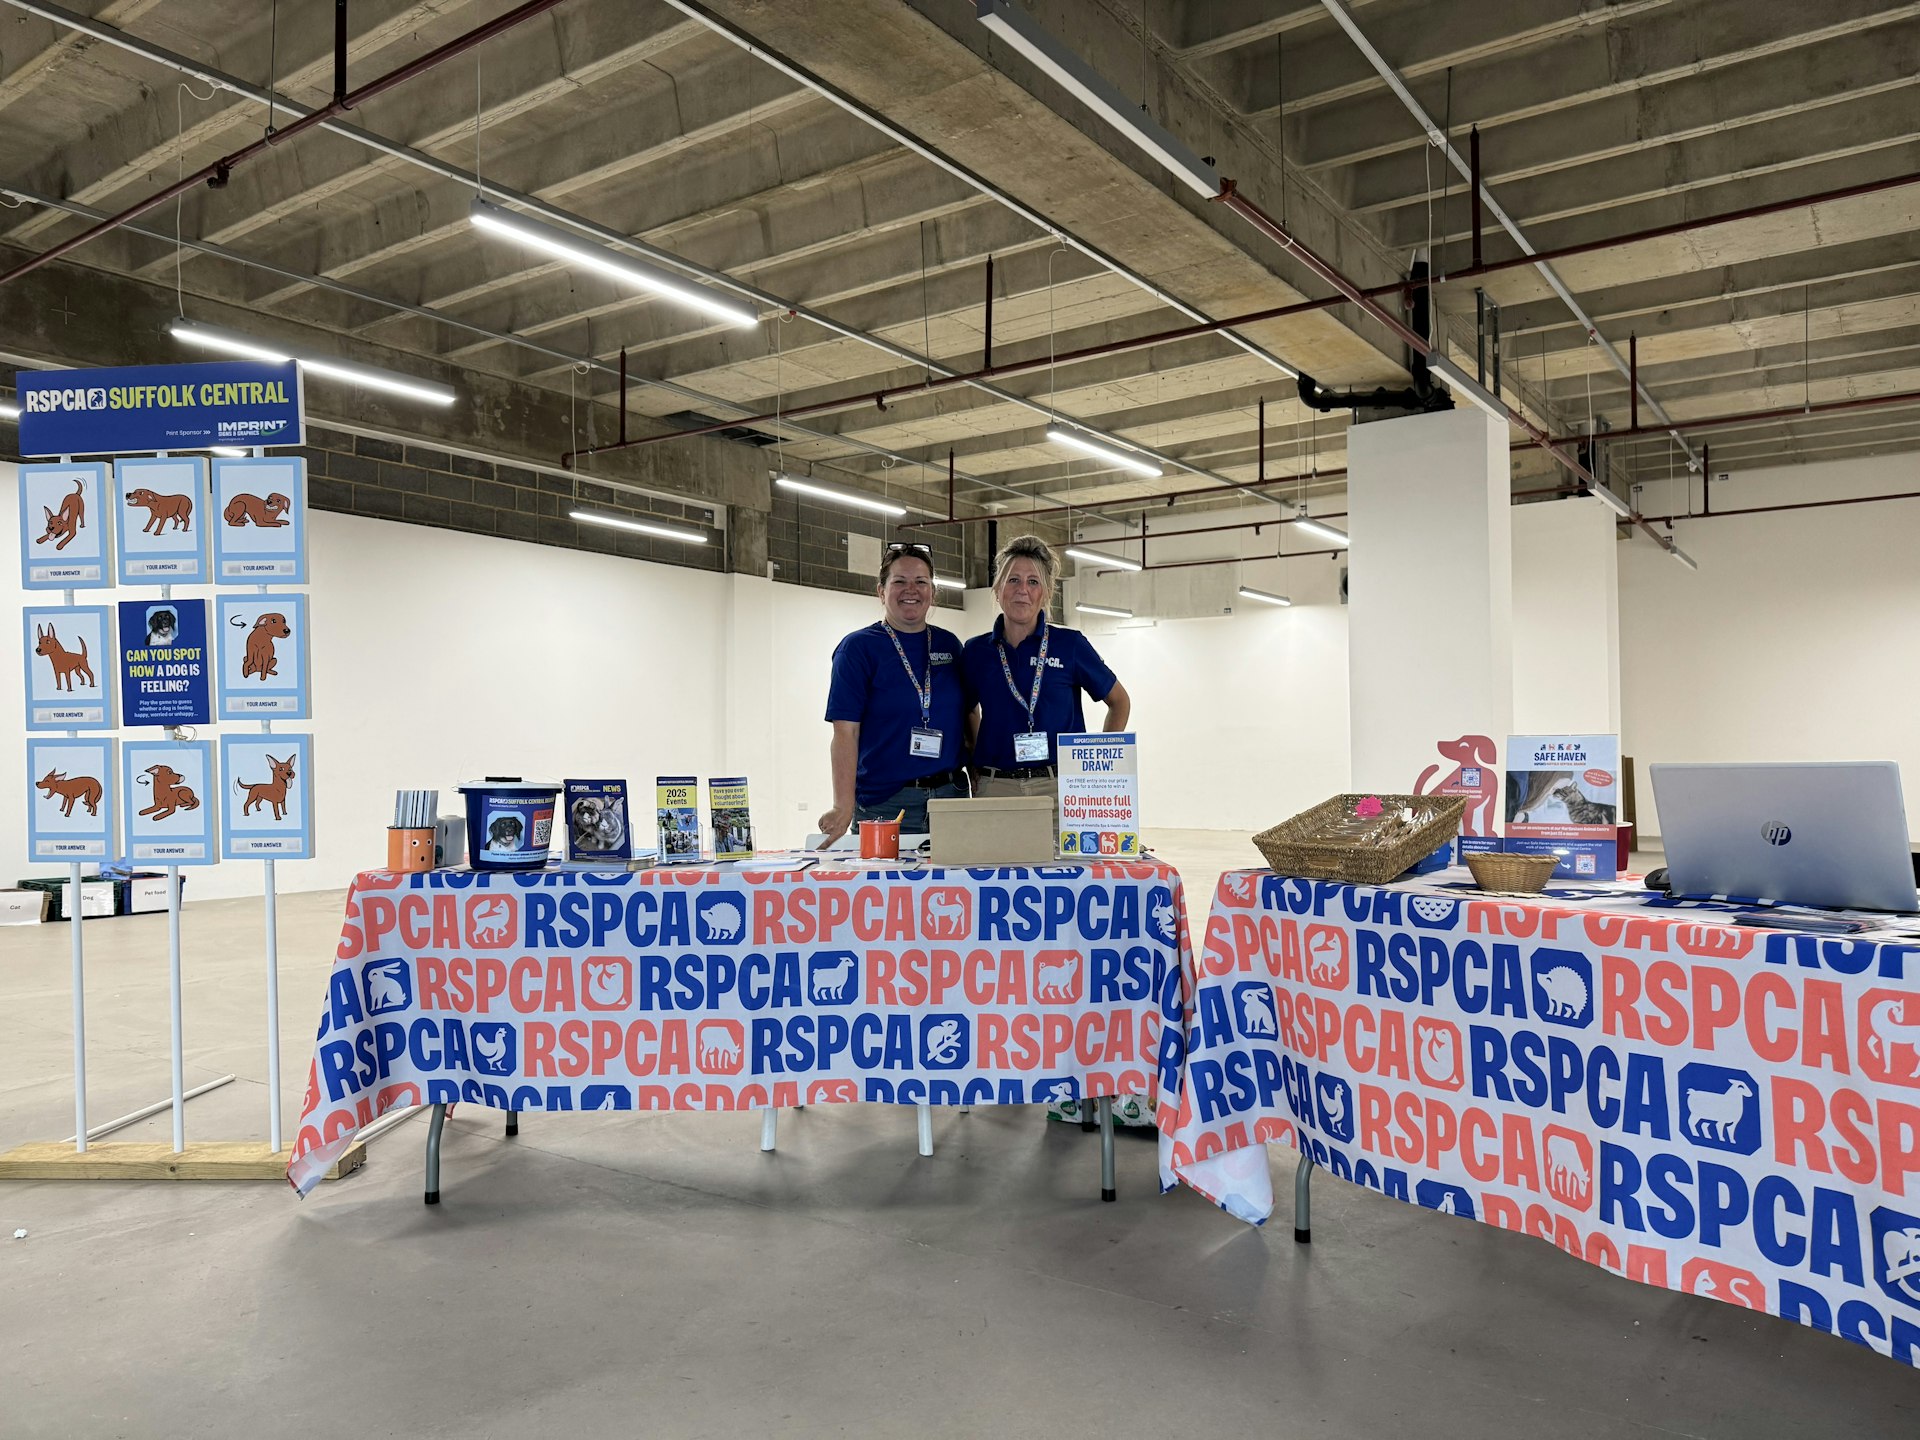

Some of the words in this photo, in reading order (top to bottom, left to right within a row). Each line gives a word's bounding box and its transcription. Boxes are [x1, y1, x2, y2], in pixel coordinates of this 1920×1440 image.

[26, 388, 86, 412] RSPCA
[110, 384, 196, 410] SUFFOLK
[200, 381, 289, 406] CENTRAL
[218, 420, 287, 431] IMPRINT
[126, 650, 148, 662] CAN
[150, 649, 172, 661] YOU
[174, 648, 201, 660] SPOT
[130, 666, 154, 677] HOW
[157, 665, 164, 676] A
[166, 664, 188, 676] DOG
[190, 664, 200, 676] IS
[141, 680, 190, 693] FEELING?
[1072, 749, 1094, 759] FREE
[1096, 748, 1124, 759] PRIZE
[1082, 760, 1113, 771] DRAW!
[1534, 753, 1556, 761] SAFE
[1557, 753, 1586, 761] HAVEN
[667, 789, 686, 798] 2025
[1064, 795, 1076, 806] 60
[1078, 795, 1112, 806] minute
[1114, 795, 1131, 806] full
[1064, 807, 1086, 819] body
[1089, 809, 1132, 820] massage
[336, 893, 460, 959] SPCA
[525, 891, 690, 948] RSPCA
[752, 884, 916, 945] RSPCA
[978, 884, 1140, 941] RSPCA
[865, 948, 1028, 1006] RSPCA
[1200, 914, 1304, 982] SPCA
[1356, 928, 1528, 1019] RSPCA
[416, 956, 576, 1013] RSPCA
[640, 950, 803, 1011] RSPCA
[751, 1012, 914, 1075] RSPCA
[976, 1008, 1136, 1071] RSPCA
[1275, 985, 1414, 1084] RSPCA
[1602, 954, 1852, 1076] RSPCA
[320, 1018, 470, 1103] RSPCA
[523, 1018, 690, 1078] RSPCA
[1190, 1048, 1316, 1130] RSPCA
[1470, 1024, 1672, 1142] RSPCA
[1358, 1082, 1542, 1193] RSPCA
[1771, 1075, 1920, 1198] RSP
[1600, 1139, 1865, 1288] RSPCA
